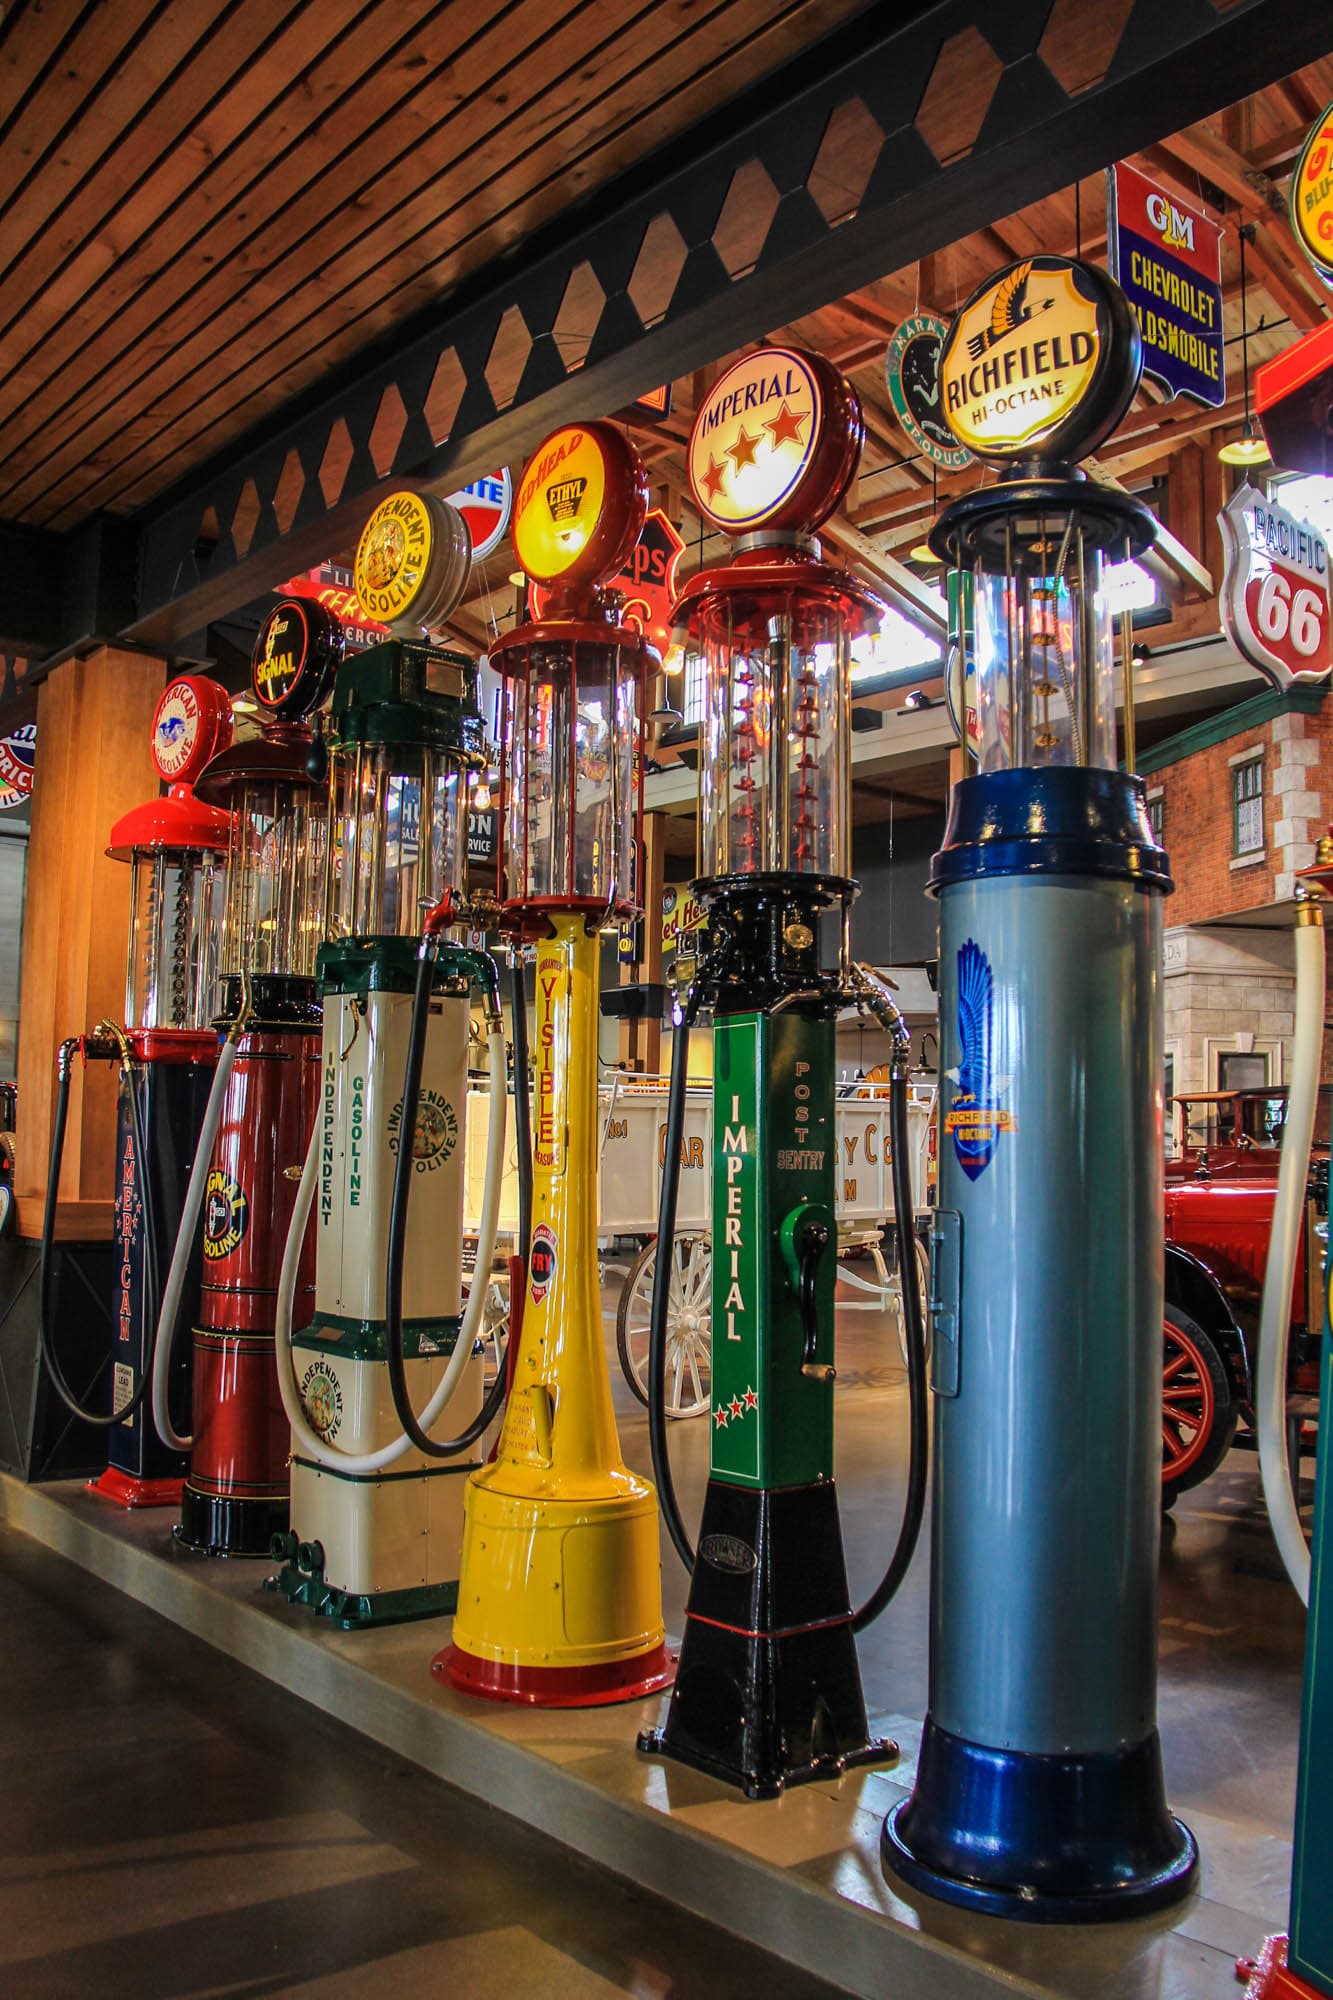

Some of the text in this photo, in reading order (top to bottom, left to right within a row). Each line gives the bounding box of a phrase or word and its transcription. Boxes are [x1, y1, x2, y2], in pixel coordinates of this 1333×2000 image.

[1131, 250, 1215, 328] CHEVROLET
[701, 370, 801, 438] IMPERIAL
[947, 330, 1095, 413] RICHFIELD
[971, 379, 1065, 425] HI-OCTANE
[550, 479, 583, 506] ETHYL
[1254, 505, 1326, 574] PACIFIC
[1257, 572, 1323, 656] 66
[257, 651, 296, 685] SIGNAL
[539, 977, 556, 1143] VISIBLE
[388, 1089, 458, 1133] INDENDENT
[794, 1062, 810, 1143] POST
[321, 1052, 336, 1226] INDEPENDENT
[350, 1076, 365, 1206] GASOLINE
[389, 1138, 457, 1173] GOLINE
[777, 1151, 825, 1170] SENTRY
[207, 1172, 246, 1216] GNAL
[722, 1095, 748, 1341] IMPERIAL
[119, 1136, 135, 1341] AMERICAN
[204, 1226, 242, 1257] SOLINE
[532, 1253, 552, 1271] FRY
